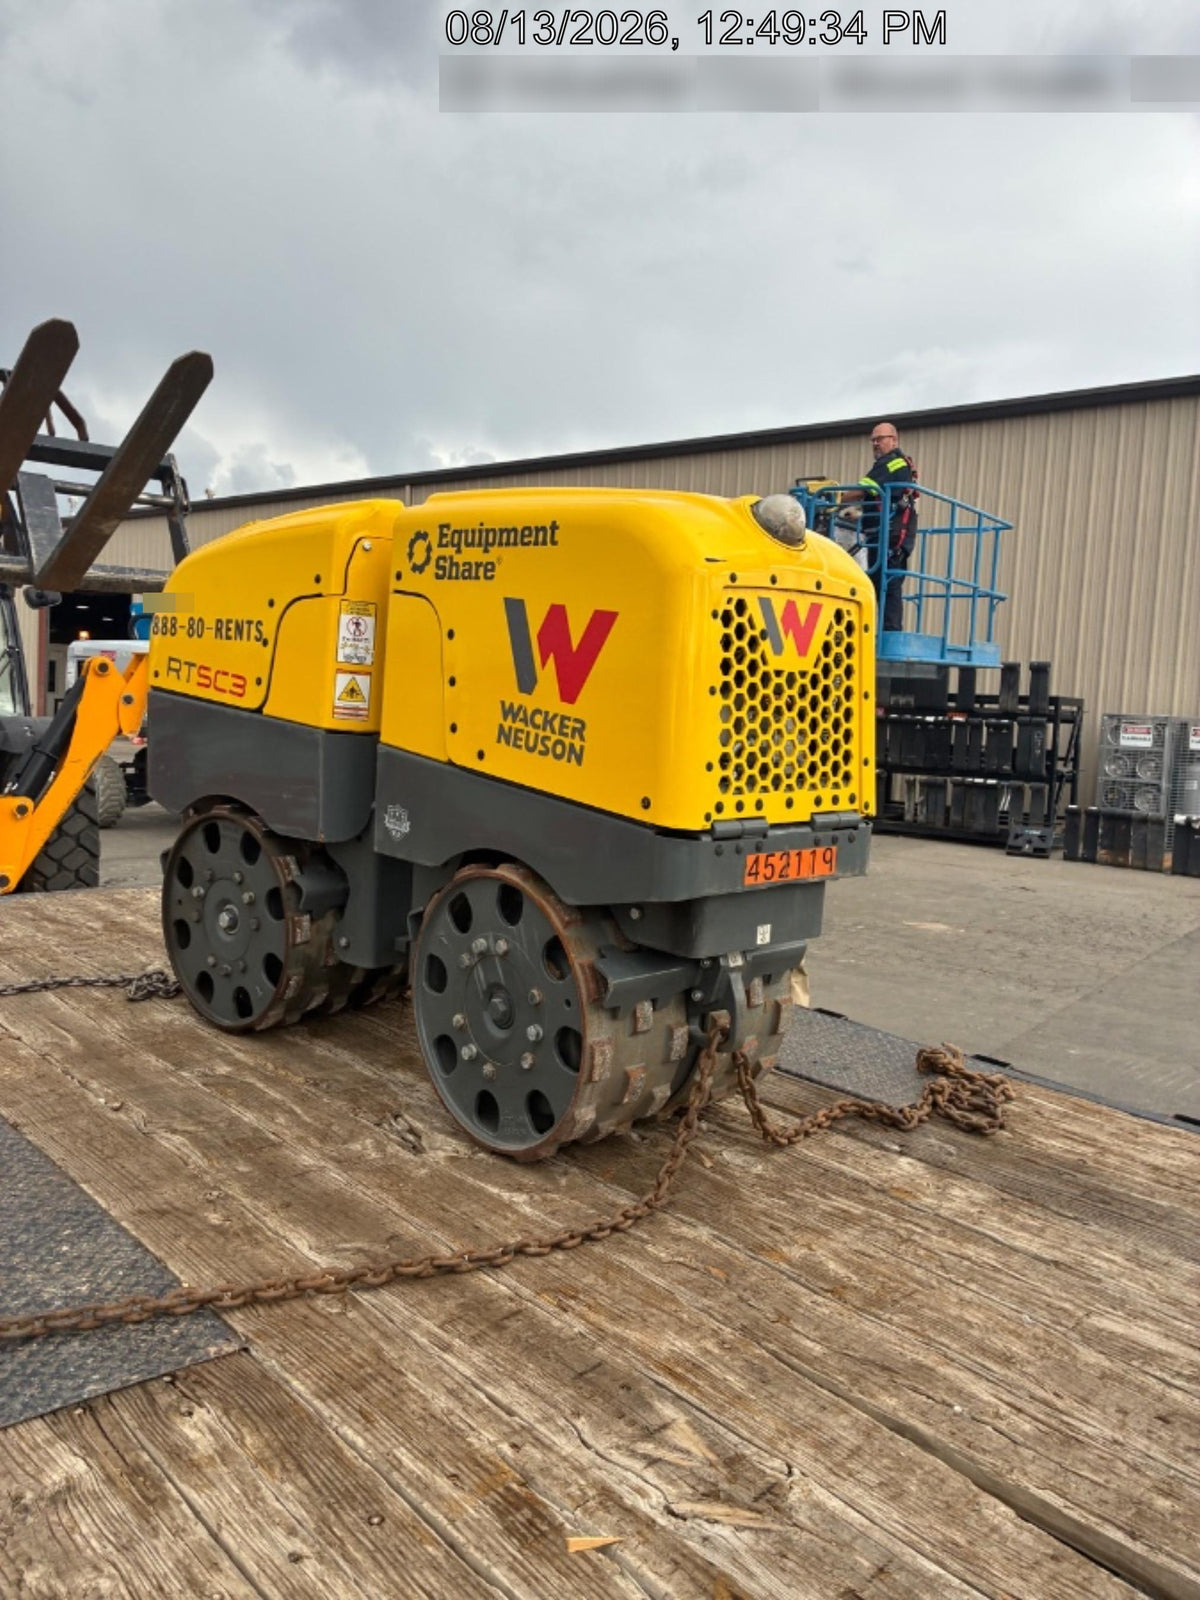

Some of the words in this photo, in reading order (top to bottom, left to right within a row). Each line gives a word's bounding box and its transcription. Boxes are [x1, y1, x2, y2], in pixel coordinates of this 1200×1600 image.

[436, 520, 560, 554] Equipment
[434, 554, 497, 581] Share
[152, 614, 264, 643] 888-80-RENTS
[166, 655, 248, 699] RTSC3
[499, 699, 588, 743] WACKER
[495, 723, 586, 768] NEUSON
[747, 847, 834, 882] 452119
